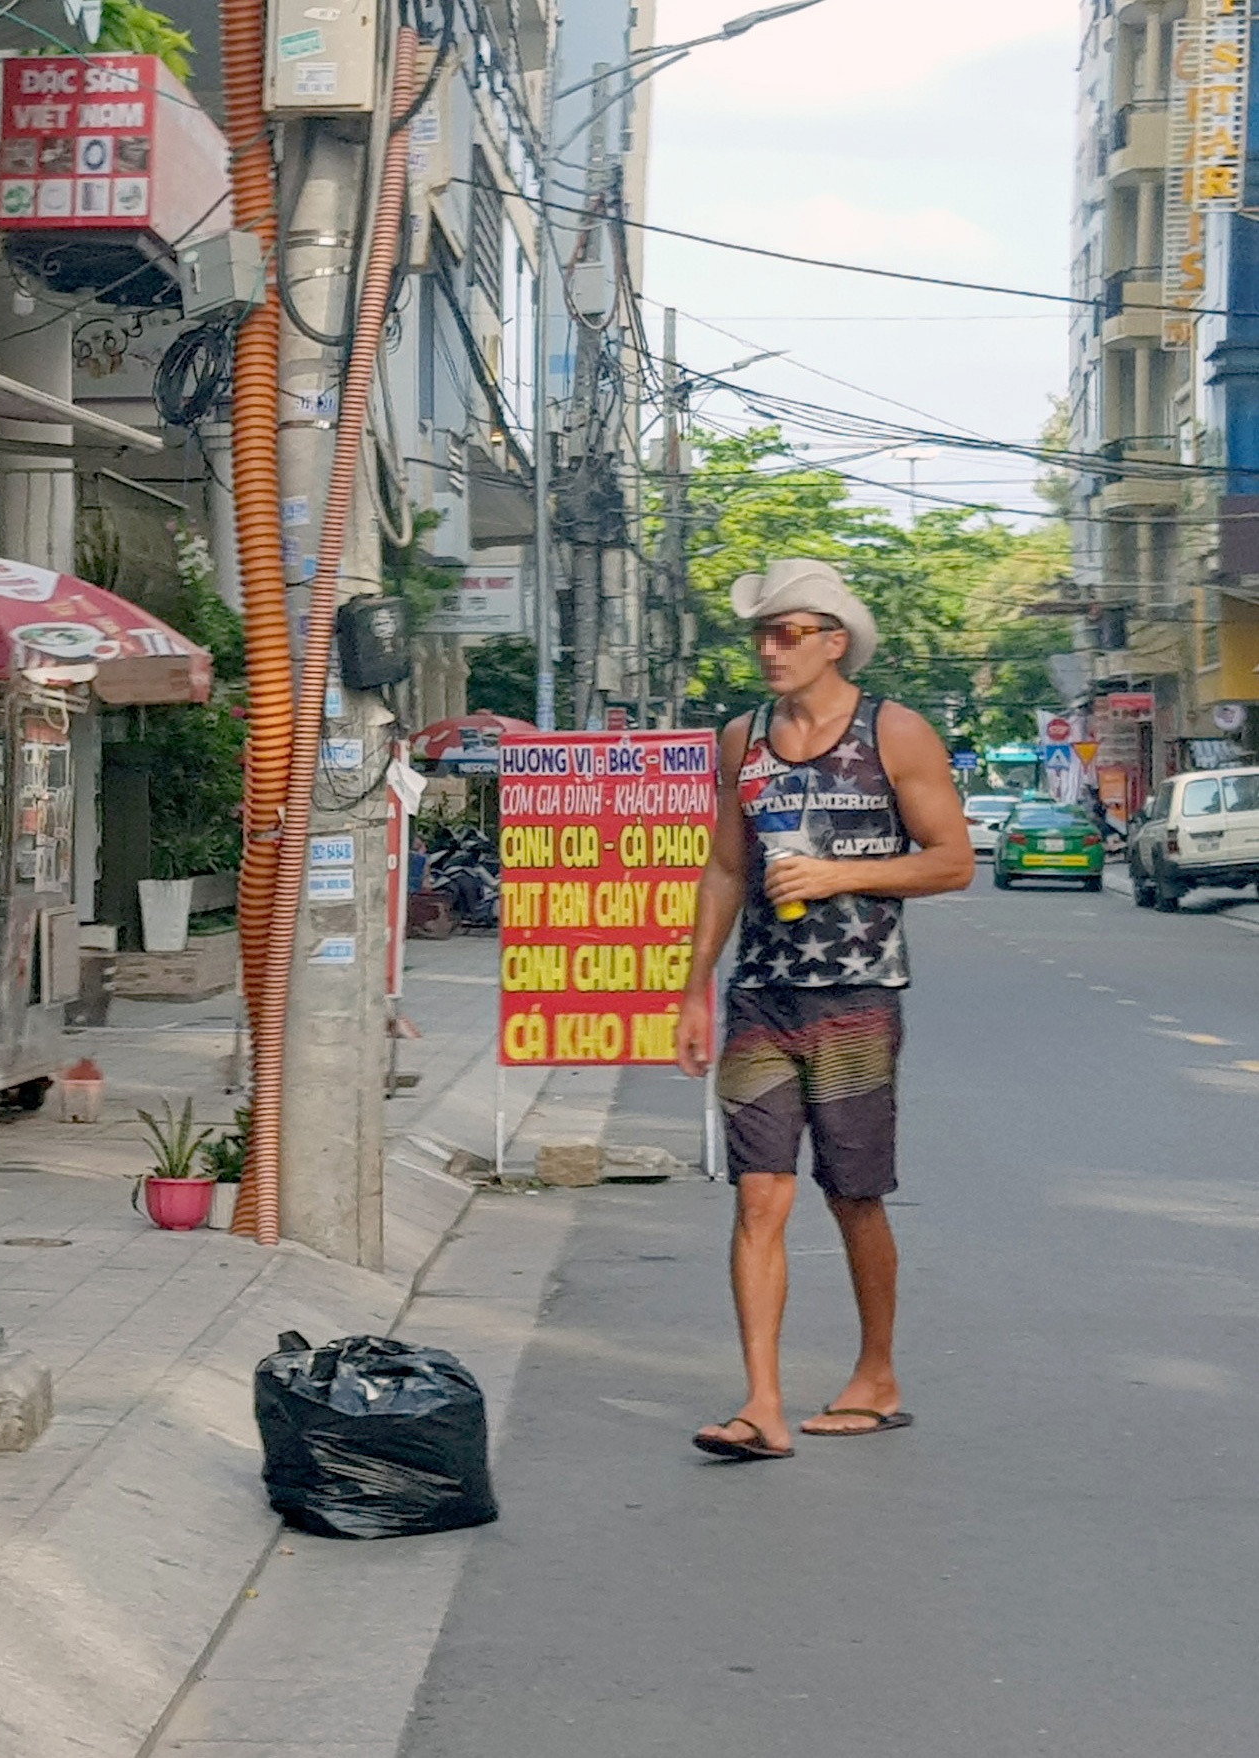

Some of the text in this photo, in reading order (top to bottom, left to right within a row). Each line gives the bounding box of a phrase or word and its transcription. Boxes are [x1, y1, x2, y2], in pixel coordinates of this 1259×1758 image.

[12, 95, 145, 134] VIỆT NAM
[662, 746, 708, 773] NAM
[536, 784, 560, 815] GIA
[564, 777, 602, 815] ĐÌNH
[614, 777, 665, 815] KHÁCH
[668, 776, 711, 815] ĐOÀN
[501, 825, 554, 868] CANH
[560, 825, 600, 868] CUA
[653, 816, 711, 868] PHÁO
[655, 881, 698, 938] CẠN
[502, 945, 568, 992] CANH
[574, 945, 637, 992] CHUA
[504, 1003, 547, 1061] CÁ
[553, 1012, 625, 1061] KHO
